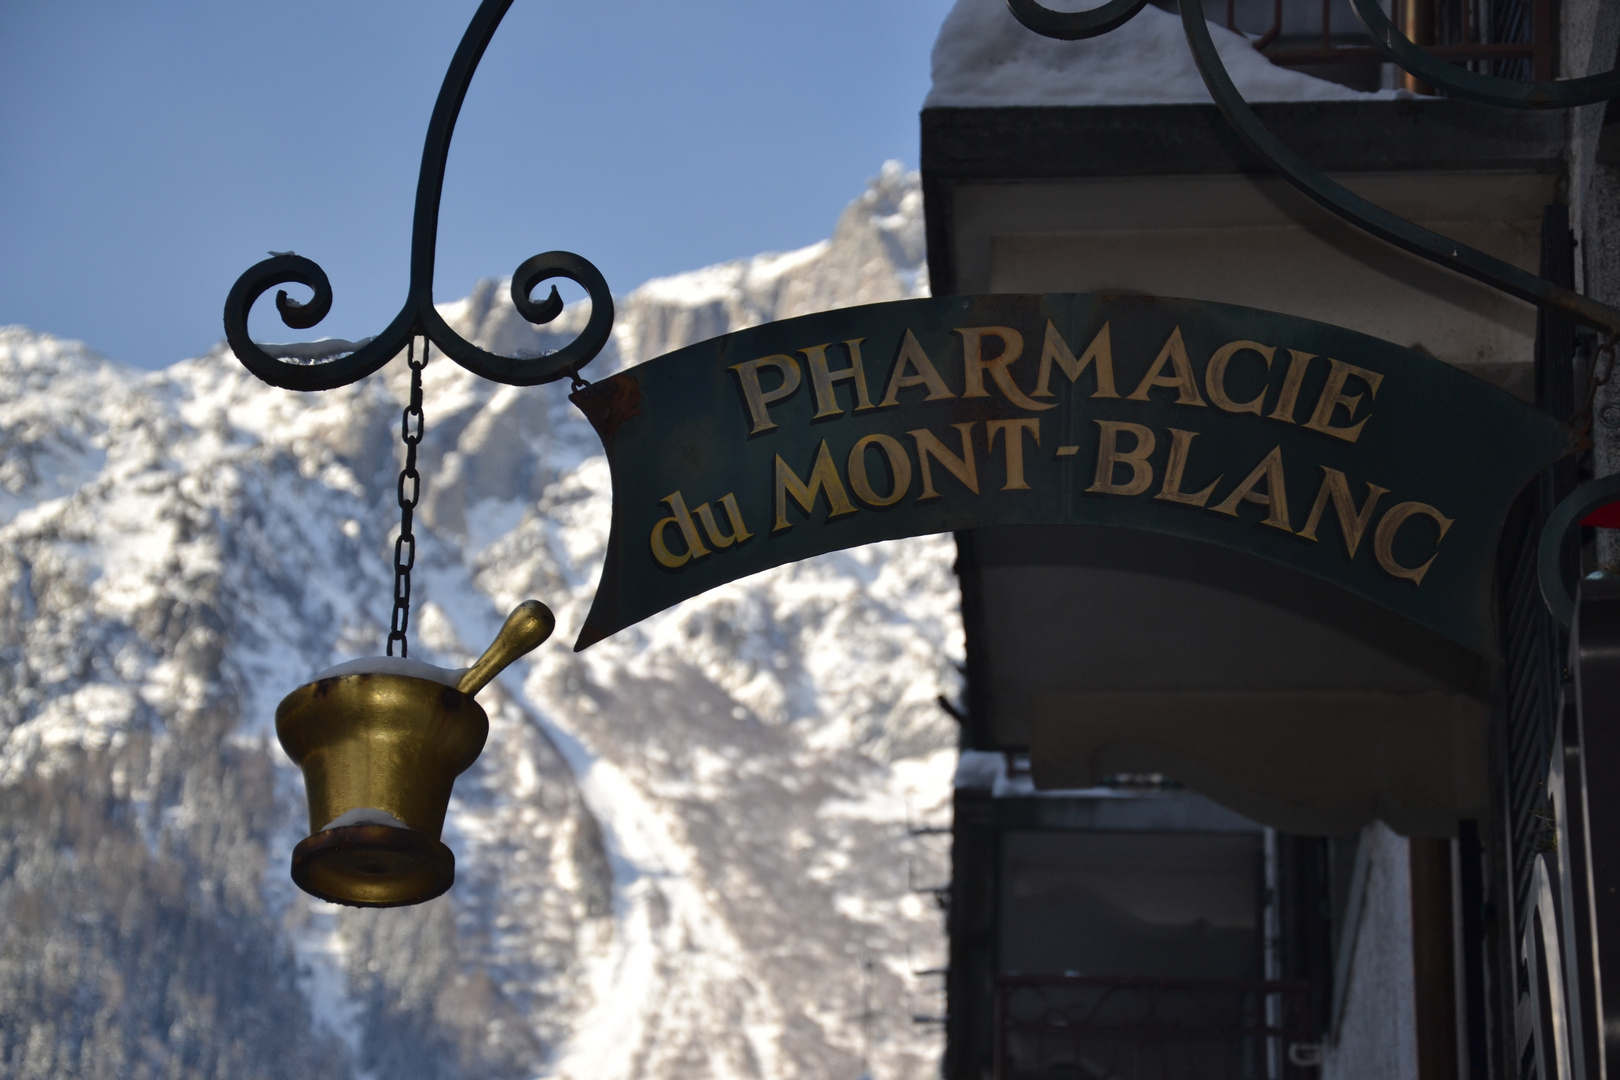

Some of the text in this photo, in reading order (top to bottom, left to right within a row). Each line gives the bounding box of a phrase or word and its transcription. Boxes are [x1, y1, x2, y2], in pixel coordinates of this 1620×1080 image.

[727, 318, 1385, 442] PHARMACIE
[650, 417, 1455, 587] du MONT-BLANC
